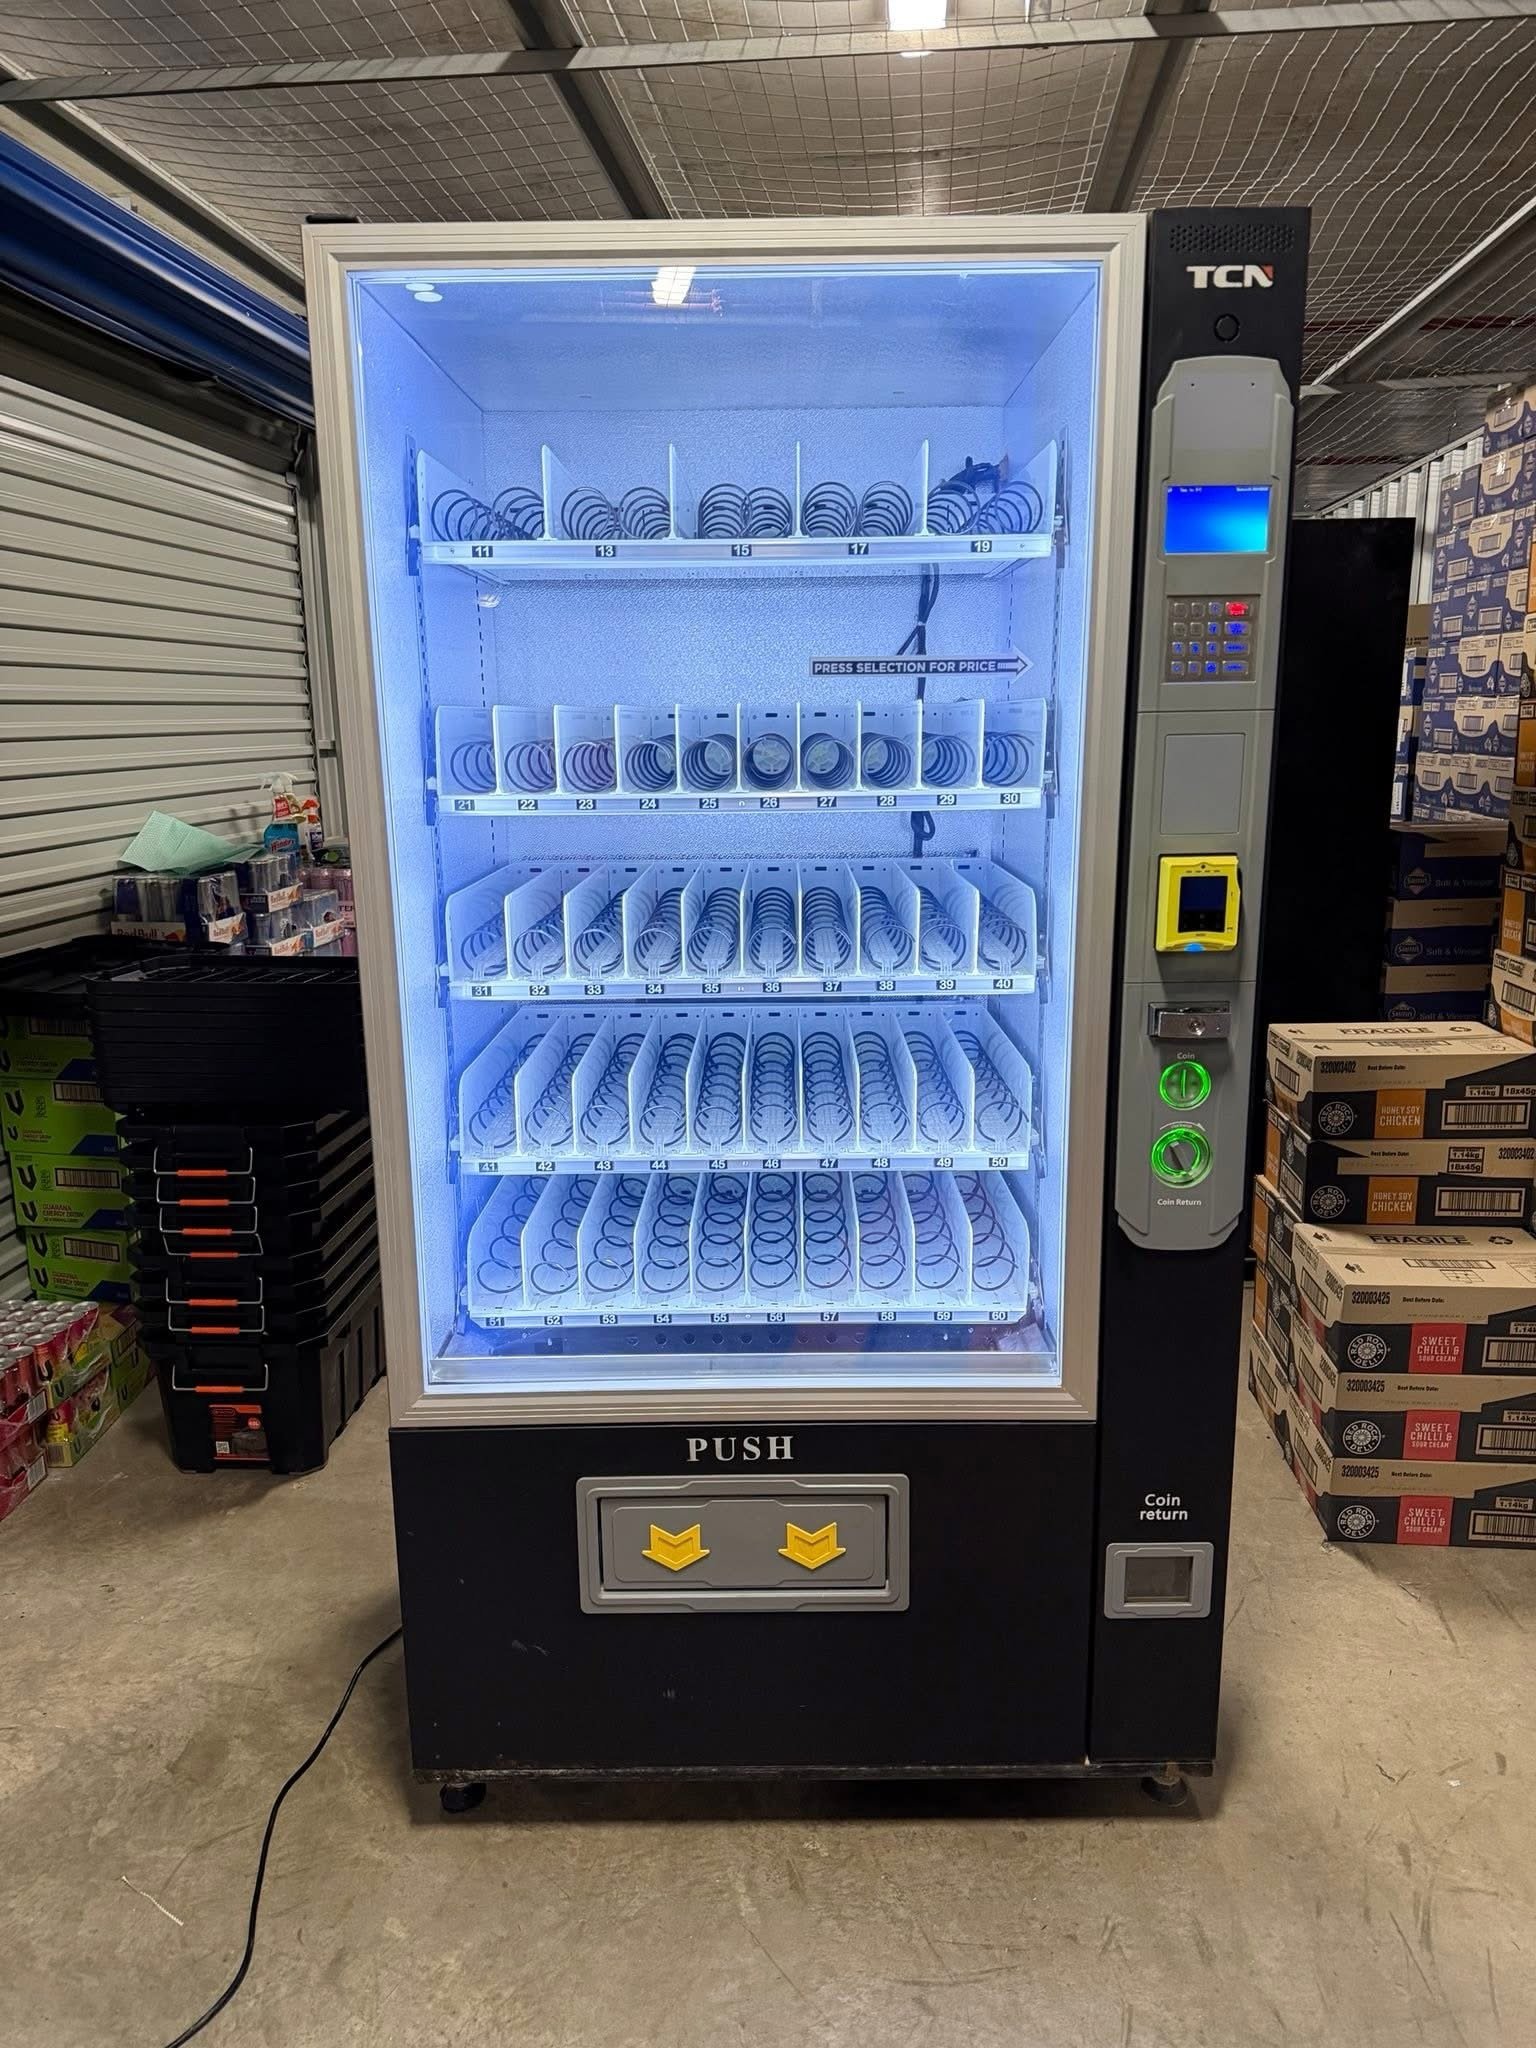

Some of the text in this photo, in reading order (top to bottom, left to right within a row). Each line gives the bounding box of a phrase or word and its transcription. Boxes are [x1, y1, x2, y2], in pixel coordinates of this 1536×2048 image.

[1186, 265, 1274, 289] TCN
[474, 541, 990, 558] 11 13 15 17 19
[814, 661, 996, 673] PRESS SELECTION FOR PRICE
[457, 793, 1018, 811] 21 22 23 24 25 26 27 28 29 30
[473, 979, 1011, 996] 31 32 33 34 35 36 37 38 39 40
[1380, 1115, 1421, 1126] CHICKEN
[1326, 1124, 1347, 1133] DELI
[481, 1157, 1006, 1172] 41 42 43 44 45 46 47 48 49 50
[1317, 1208, 1339, 1217] DELI
[1371, 1201, 1413, 1212] CHICKEN
[1368, 1234, 1468, 1245] FRAGILE
[488, 1311, 1006, 1326] 51 52 53 54 55 56 57 58 59 60
[1351, 1336, 1384, 1354] RED ROCK
[1421, 1336, 1457, 1346] SWEET
[1417, 1346, 1451, 1355] CHILLI
[1355, 1357, 1378, 1367] DELI
[1346, 1380, 1385, 1392] 320003425
[1345, 1423, 1378, 1441] RED ROCK
[1415, 1423, 1450, 1432] SWEET
[1410, 1432, 1444, 1441] CHILLI
[686, 1435, 794, 1462] PUSH
[1350, 1444, 1373, 1453] DELI
[1341, 1465, 1379, 1478] 320003425
[1145, 1493, 1181, 1507] Coin
[1140, 1508, 1188, 1521] return
[1340, 1508, 1373, 1525] RED ROCK
[1409, 1508, 1443, 1517] SWEET
[1404, 1517, 1437, 1526] CHILLI
[1345, 1528, 1367, 1537] DELI
